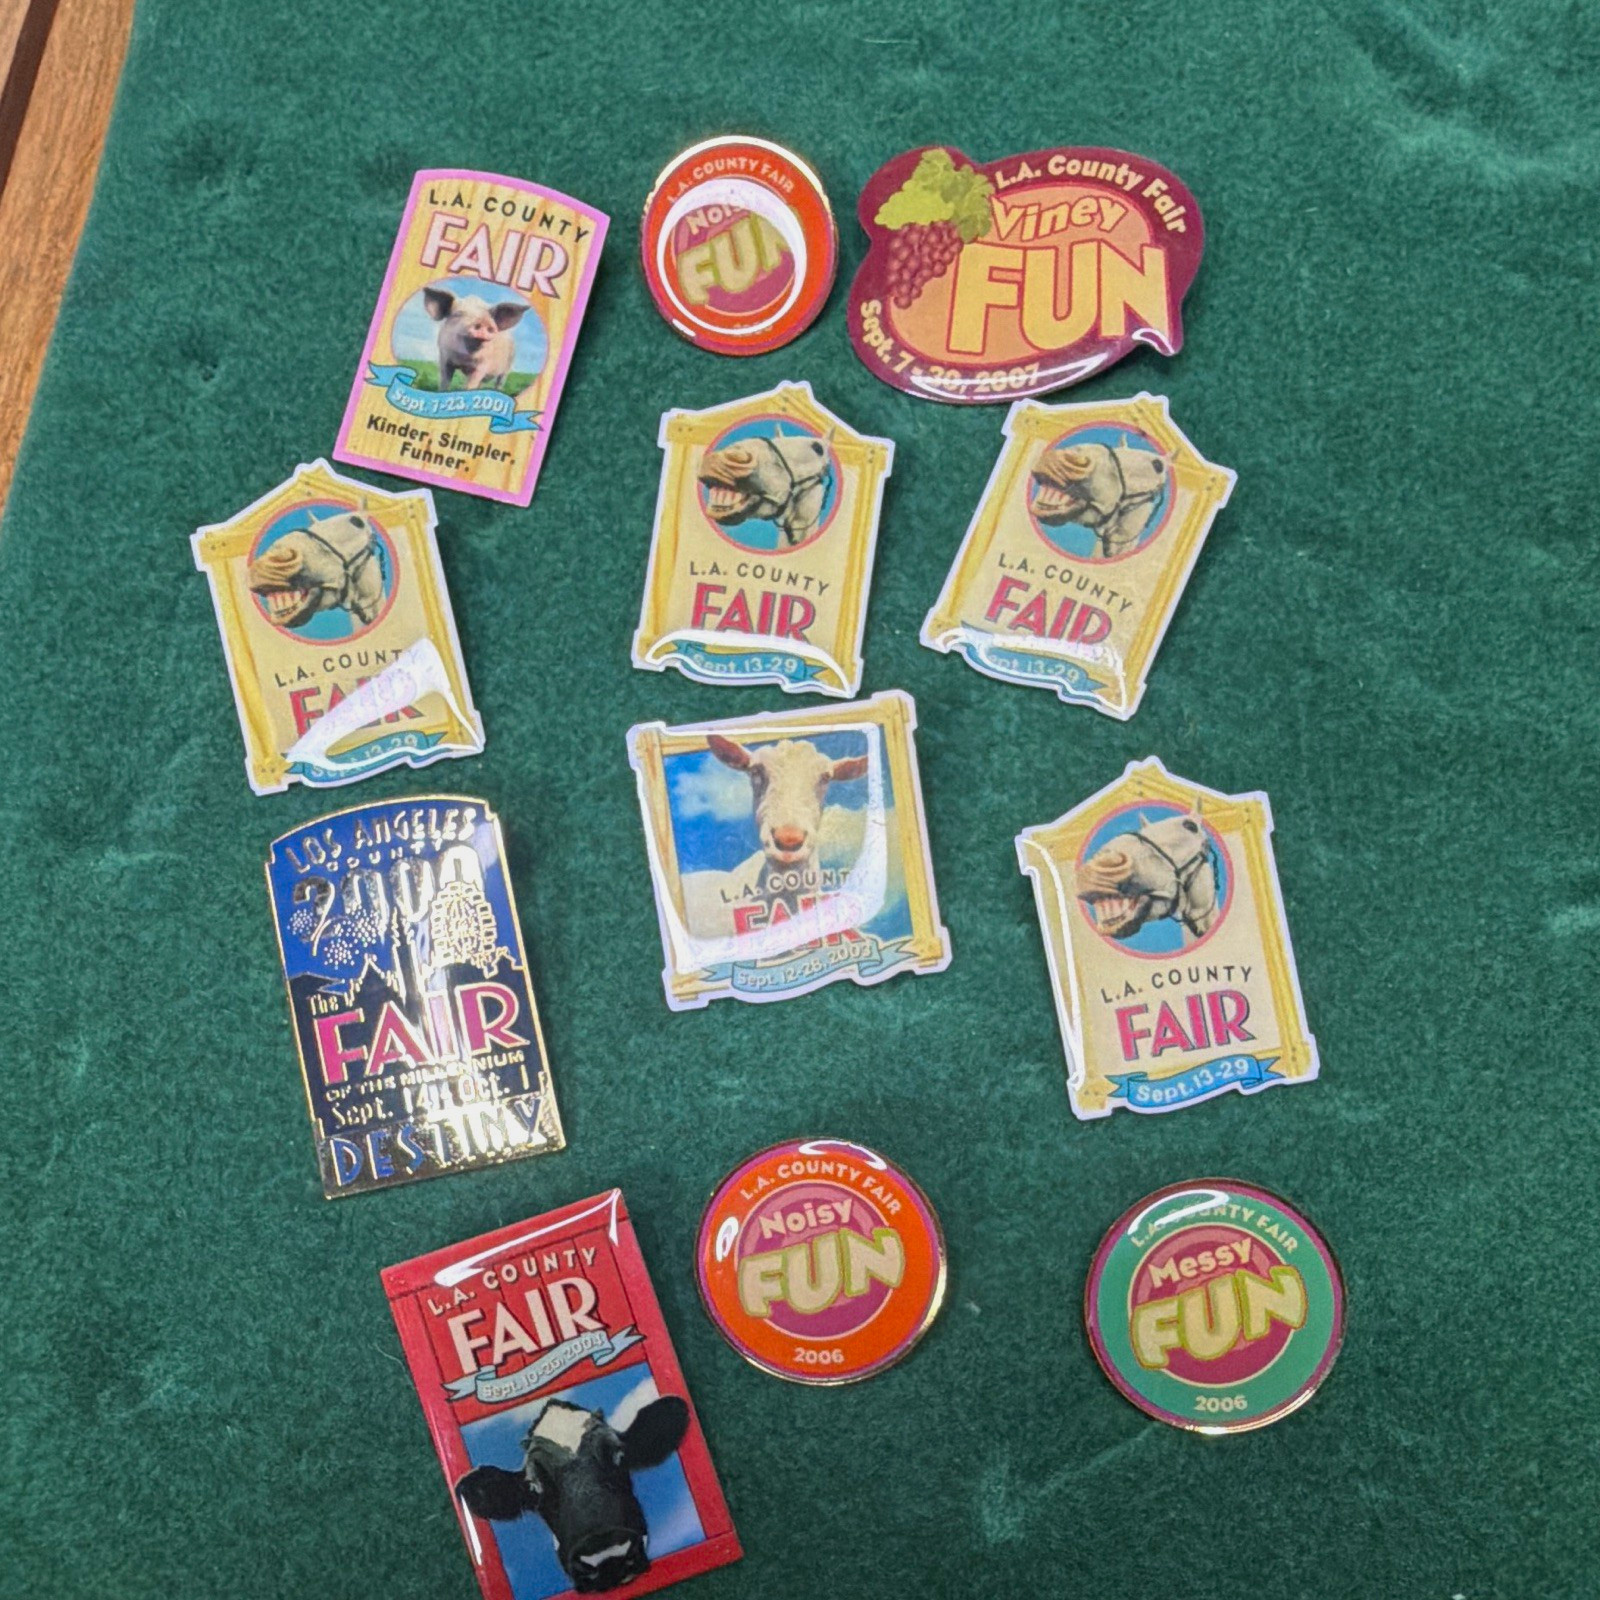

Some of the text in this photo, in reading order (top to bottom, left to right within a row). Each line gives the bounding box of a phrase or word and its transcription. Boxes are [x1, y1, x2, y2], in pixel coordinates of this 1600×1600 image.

[692, 157, 759, 180] COUNTY
[761, 163, 795, 193] FAIR
[995, 154, 1187, 234] L.A. County Fair
[429, 189, 590, 243] L.A. COUNTY
[419, 210, 570, 300] FAIR
[946, 238, 1170, 357] FUN
[860, 300, 895, 364] Sept.
[400, 441, 470, 472] Funner.
[438, 432, 516, 466] Simpler.
[690, 560, 830, 597] L.A. COUNTY
[998, 552, 1133, 613] L.A. COUNTY
[691, 582, 816, 645] FAIR
[274, 648, 419, 688] L.A. COUNT
[285, 807, 477, 874] LOS ANGELES
[720, 869, 863, 904] L.A. COUNT
[1100, 965, 1253, 1004] L.A. COUNTY
[313, 981, 531, 1087] FAIR
[1115, 989, 1256, 1062] FAIR
[739, 1160, 904, 1216] L.A. COUNTY FAIR
[1256, 1214, 1299, 1254] FAIR
[426, 1247, 597, 1317] L.A. COUNTY
[738, 1227, 906, 1318] FUN
[446, 1276, 605, 1375] FAIR
[1130, 1264, 1309, 1370] FUN
[792, 1346, 846, 1365] 2006
[1194, 1394, 1248, 1413] 2006
